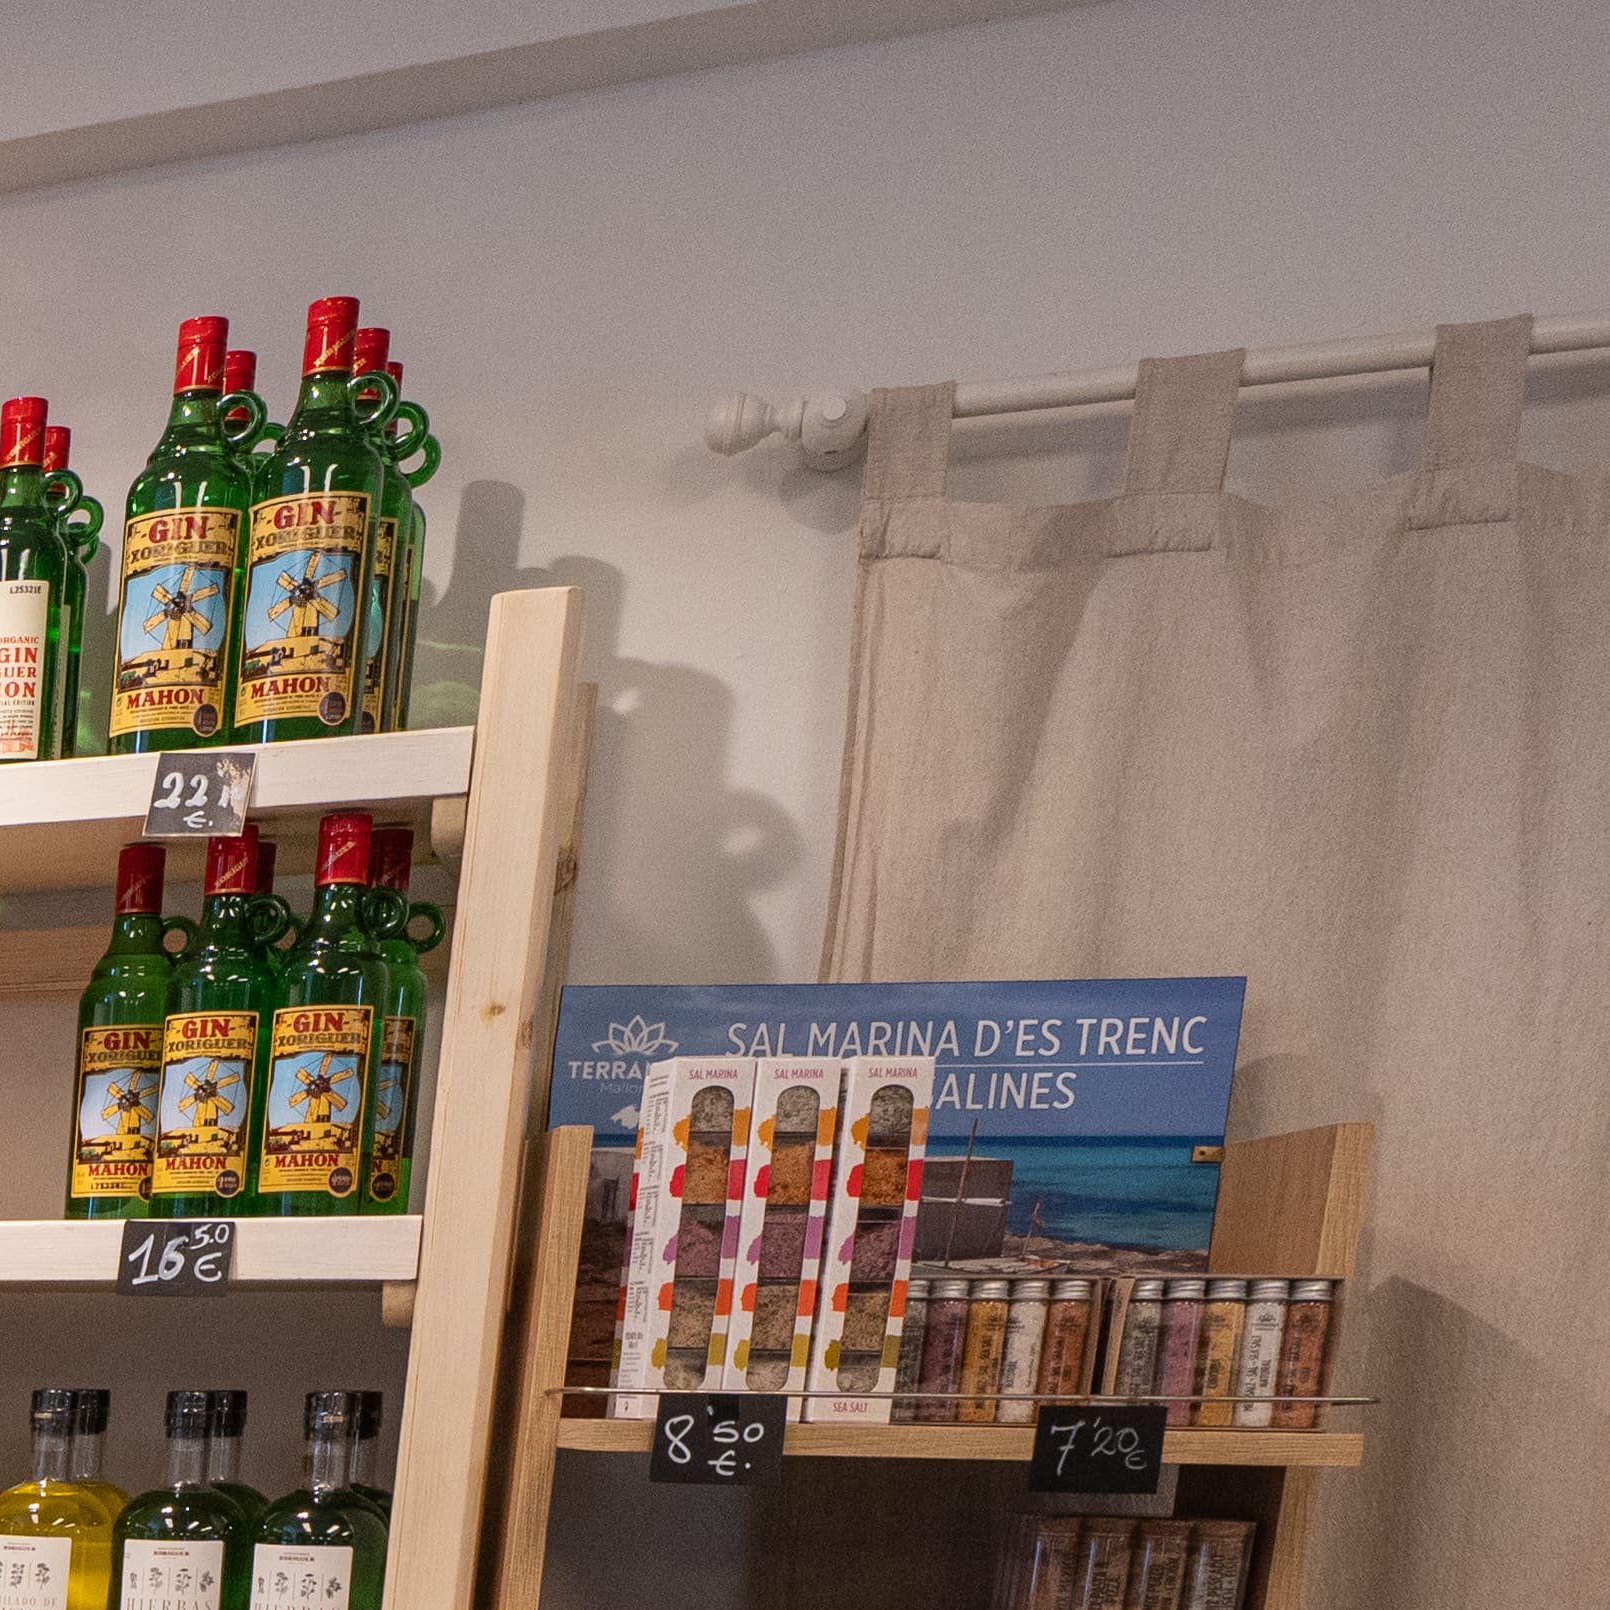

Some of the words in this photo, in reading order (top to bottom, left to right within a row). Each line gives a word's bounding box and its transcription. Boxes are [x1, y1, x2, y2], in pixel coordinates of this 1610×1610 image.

[272, 500, 335, 530] GIN
[147, 515, 209, 543] GIN
[126, 687, 205, 712] MAHON
[250, 675, 331, 700] MAHON
[806, 1019, 960, 1058] MARINA
[973, 1018, 1063, 1057] D'ES
[1074, 1015, 1209, 1056] TRENC
[688, 1069, 705, 1080] SAL
[706, 1069, 738, 1080] MARINA
[773, 1067, 788, 1079] SAL
[790, 1067, 824, 1079] MARINA
[868, 1065, 883, 1078] SAL
[885, 1065, 919, 1078] MARINA
[832, 1402, 848, 1414] SEA
[849, 1401, 870, 1413] SALT
